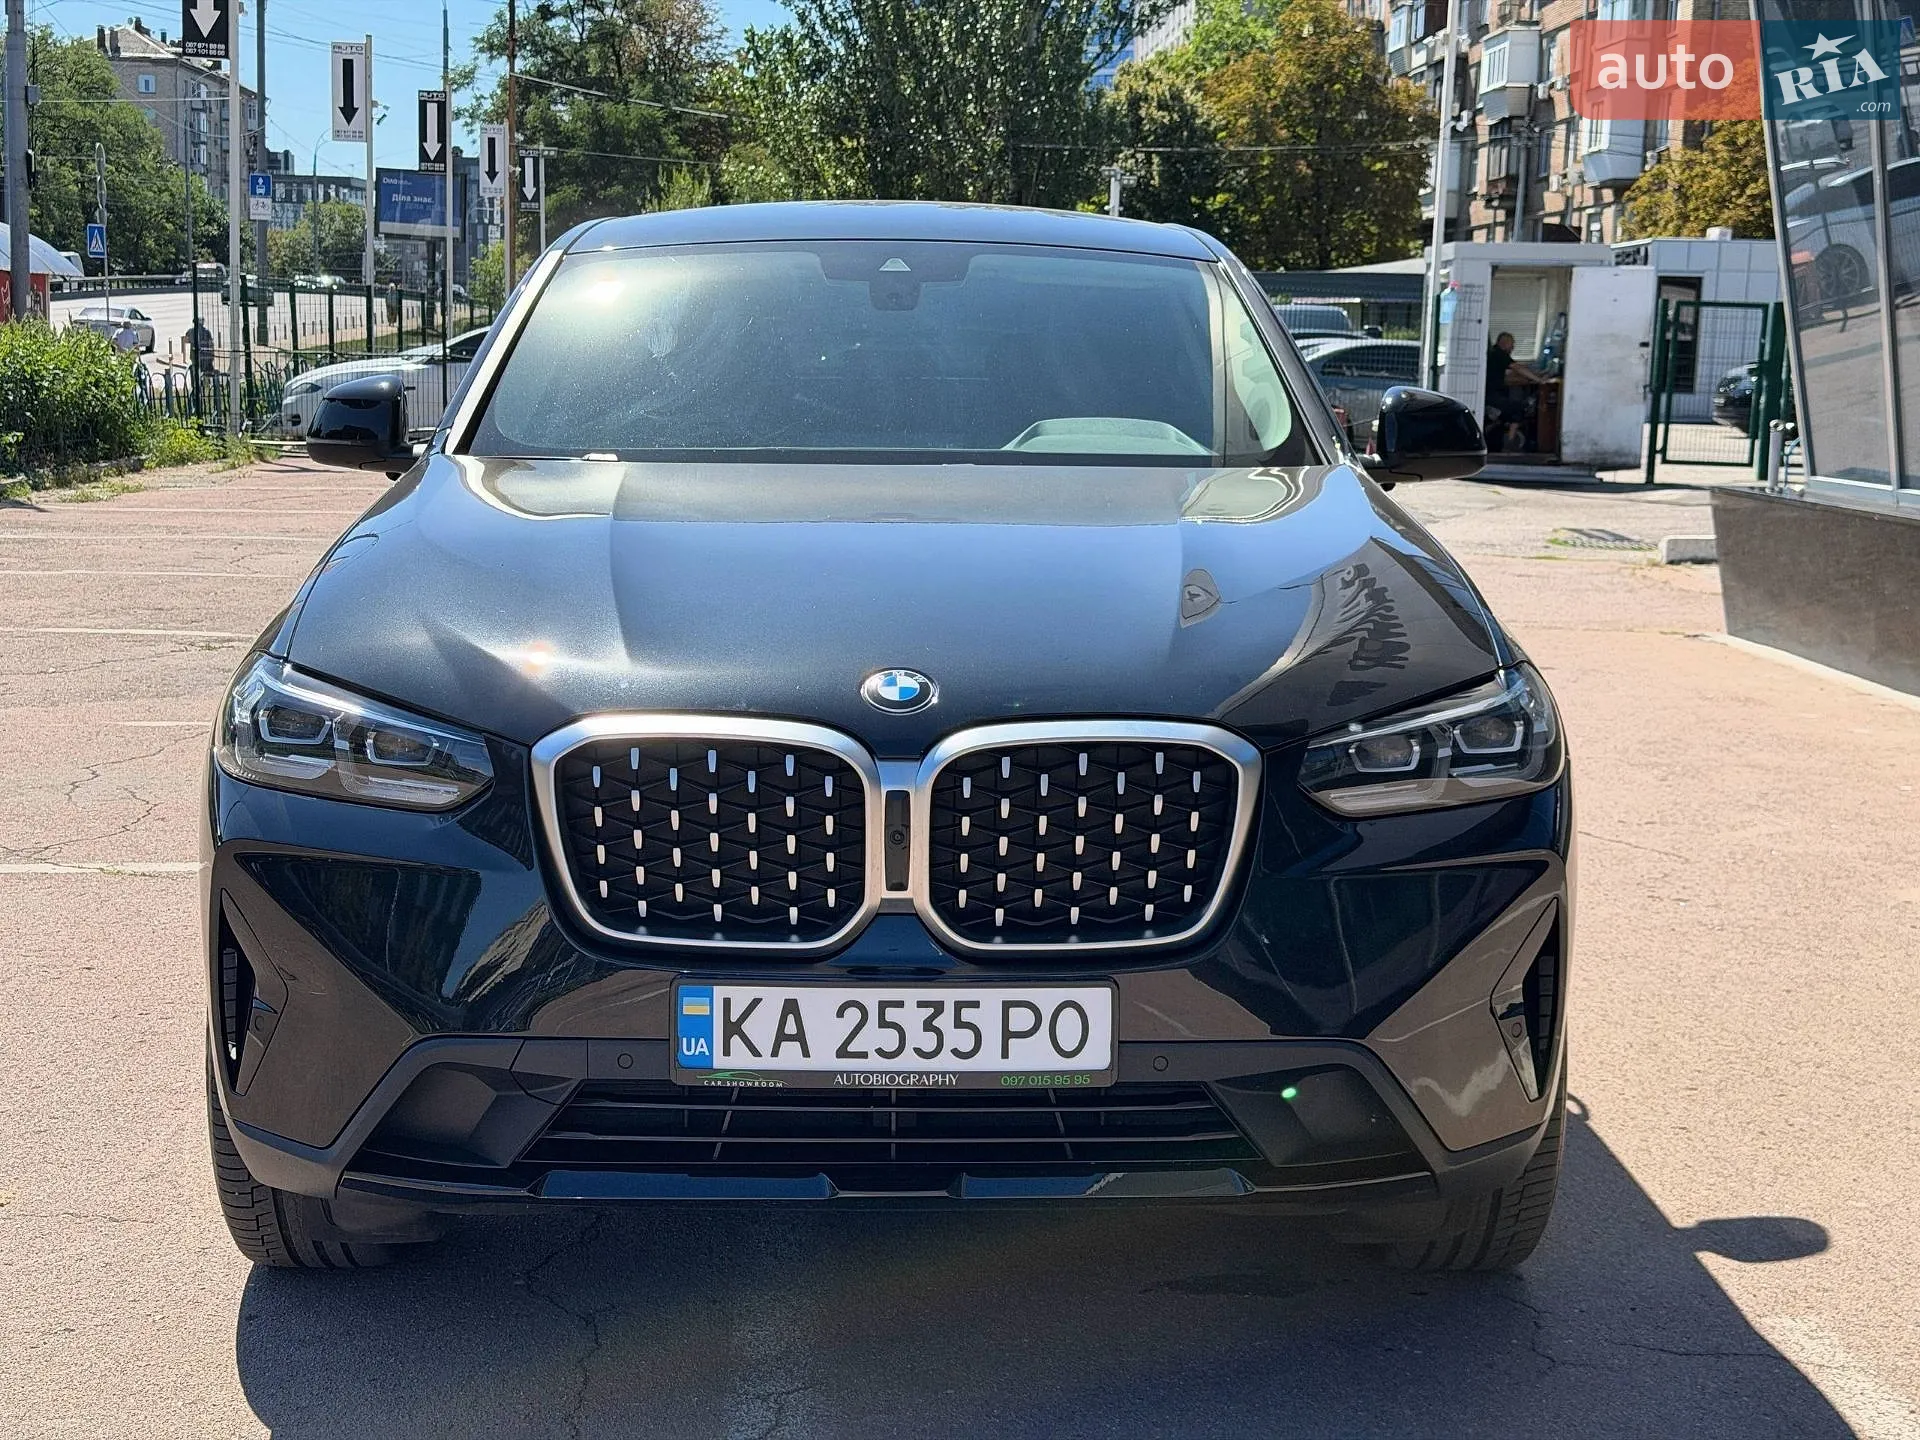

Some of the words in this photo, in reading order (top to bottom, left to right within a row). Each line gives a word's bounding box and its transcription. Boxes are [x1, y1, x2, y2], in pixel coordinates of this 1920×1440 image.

[721, 997, 812, 1059] KA
[835, 999, 983, 1061] 2535
[1000, 999, 1091, 1060] PO
[682, 1037, 710, 1057] UA
[727, 1080, 784, 1088] SHOWROOM
[834, 1073, 960, 1087] AUTOBIOGRAPHY
[1001, 1075, 1025, 1086] 097
[1028, 1075, 1051, 1086] 015
[1054, 1075, 1071, 1085] 95
[1074, 1074, 1091, 1085] 95
